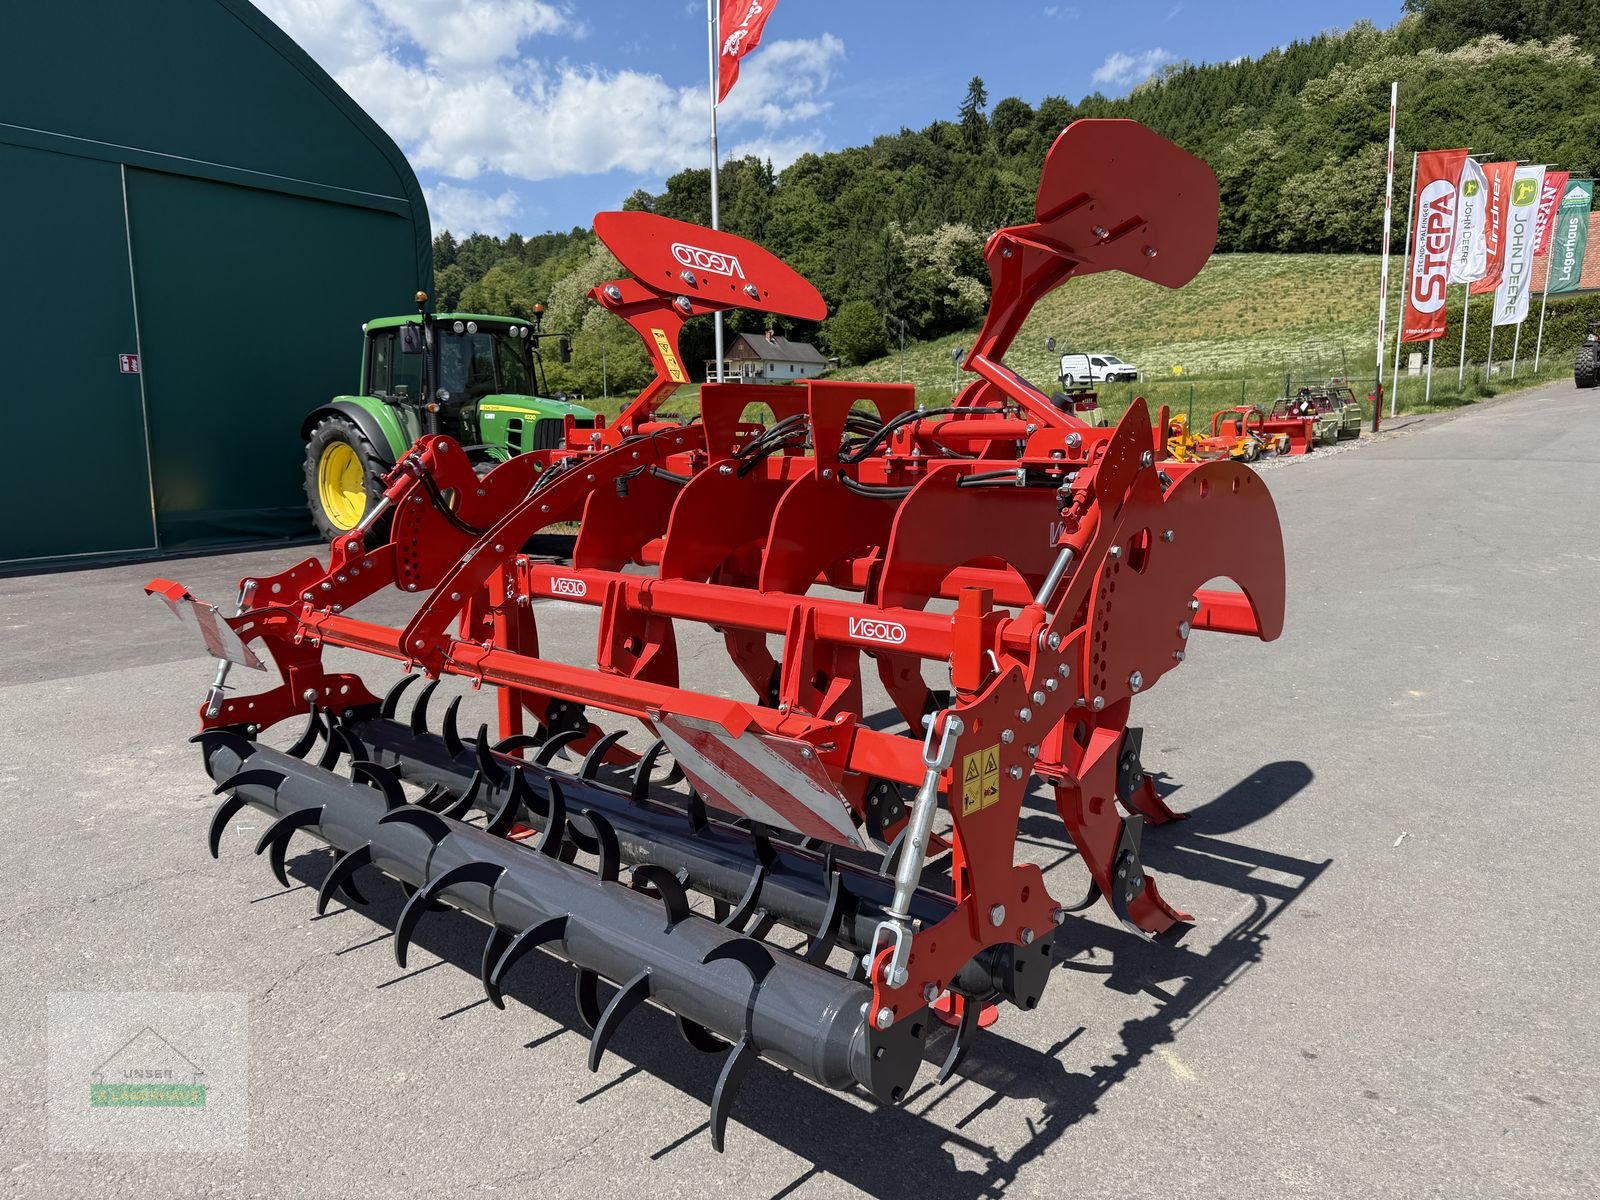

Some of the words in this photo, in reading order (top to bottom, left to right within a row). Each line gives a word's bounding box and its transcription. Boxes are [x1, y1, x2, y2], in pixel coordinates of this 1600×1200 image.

[1463, 202, 1474, 230] JOHN
[1487, 169, 1501, 256] Lindner
[1414, 191, 1455, 302] STEPA
[1417, 202, 1429, 273] STEINDL-PALFINGER
[1460, 231, 1472, 265] DEERE
[1511, 213, 1527, 259] JOHN
[1559, 217, 1579, 281] Lagerhaus
[671, 243, 745, 279] VIGOLO
[1505, 262, 1524, 315] DEERE
[551, 576, 587, 597] VIGOLO
[849, 616, 906, 644] VIGOLO
